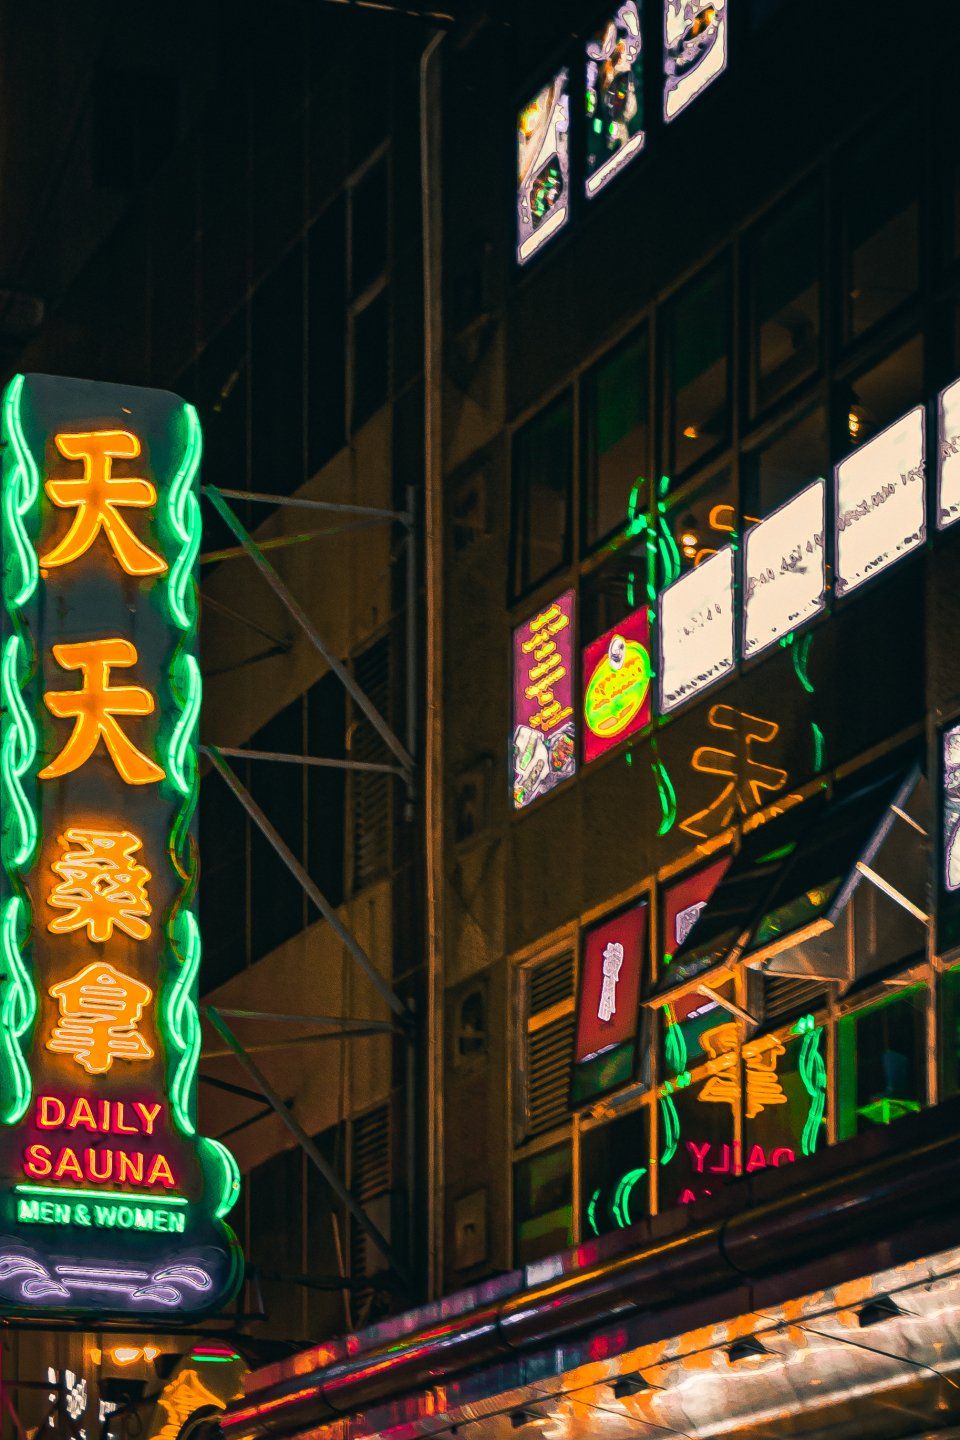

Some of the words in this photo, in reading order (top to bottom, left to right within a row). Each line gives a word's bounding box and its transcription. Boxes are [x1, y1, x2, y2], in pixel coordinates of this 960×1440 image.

[39, 429, 169, 1074] 天天桑拿
[38, 1095, 161, 1136] DAILY
[24, 1145, 175, 1187] SAUNA
[17, 1199, 70, 1225] MEN
[75, 1203, 91, 1225] &
[94, 1205, 185, 1233] WOMEN
